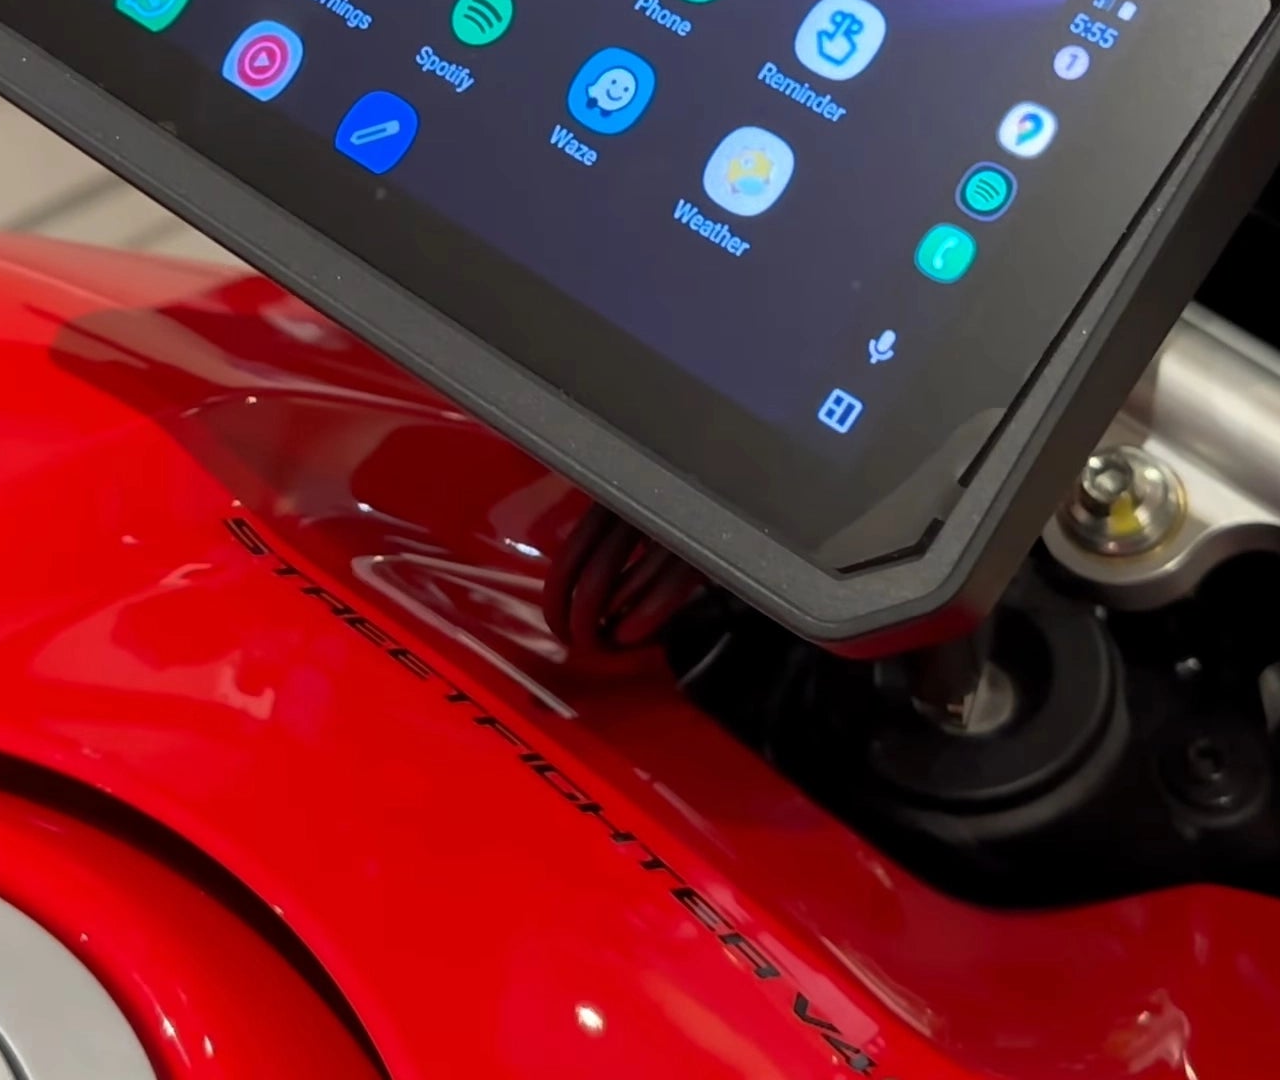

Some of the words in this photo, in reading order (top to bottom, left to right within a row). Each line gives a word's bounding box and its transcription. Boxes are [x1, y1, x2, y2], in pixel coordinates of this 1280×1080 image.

[1069, 12, 1119, 49] 5:55
[415, 45, 476, 94] Spotify
[757, 61, 847, 124] Reminder
[550, 124, 599, 167] Waze
[673, 198, 751, 258] Weather
[793, 990, 878, 1077] V4
